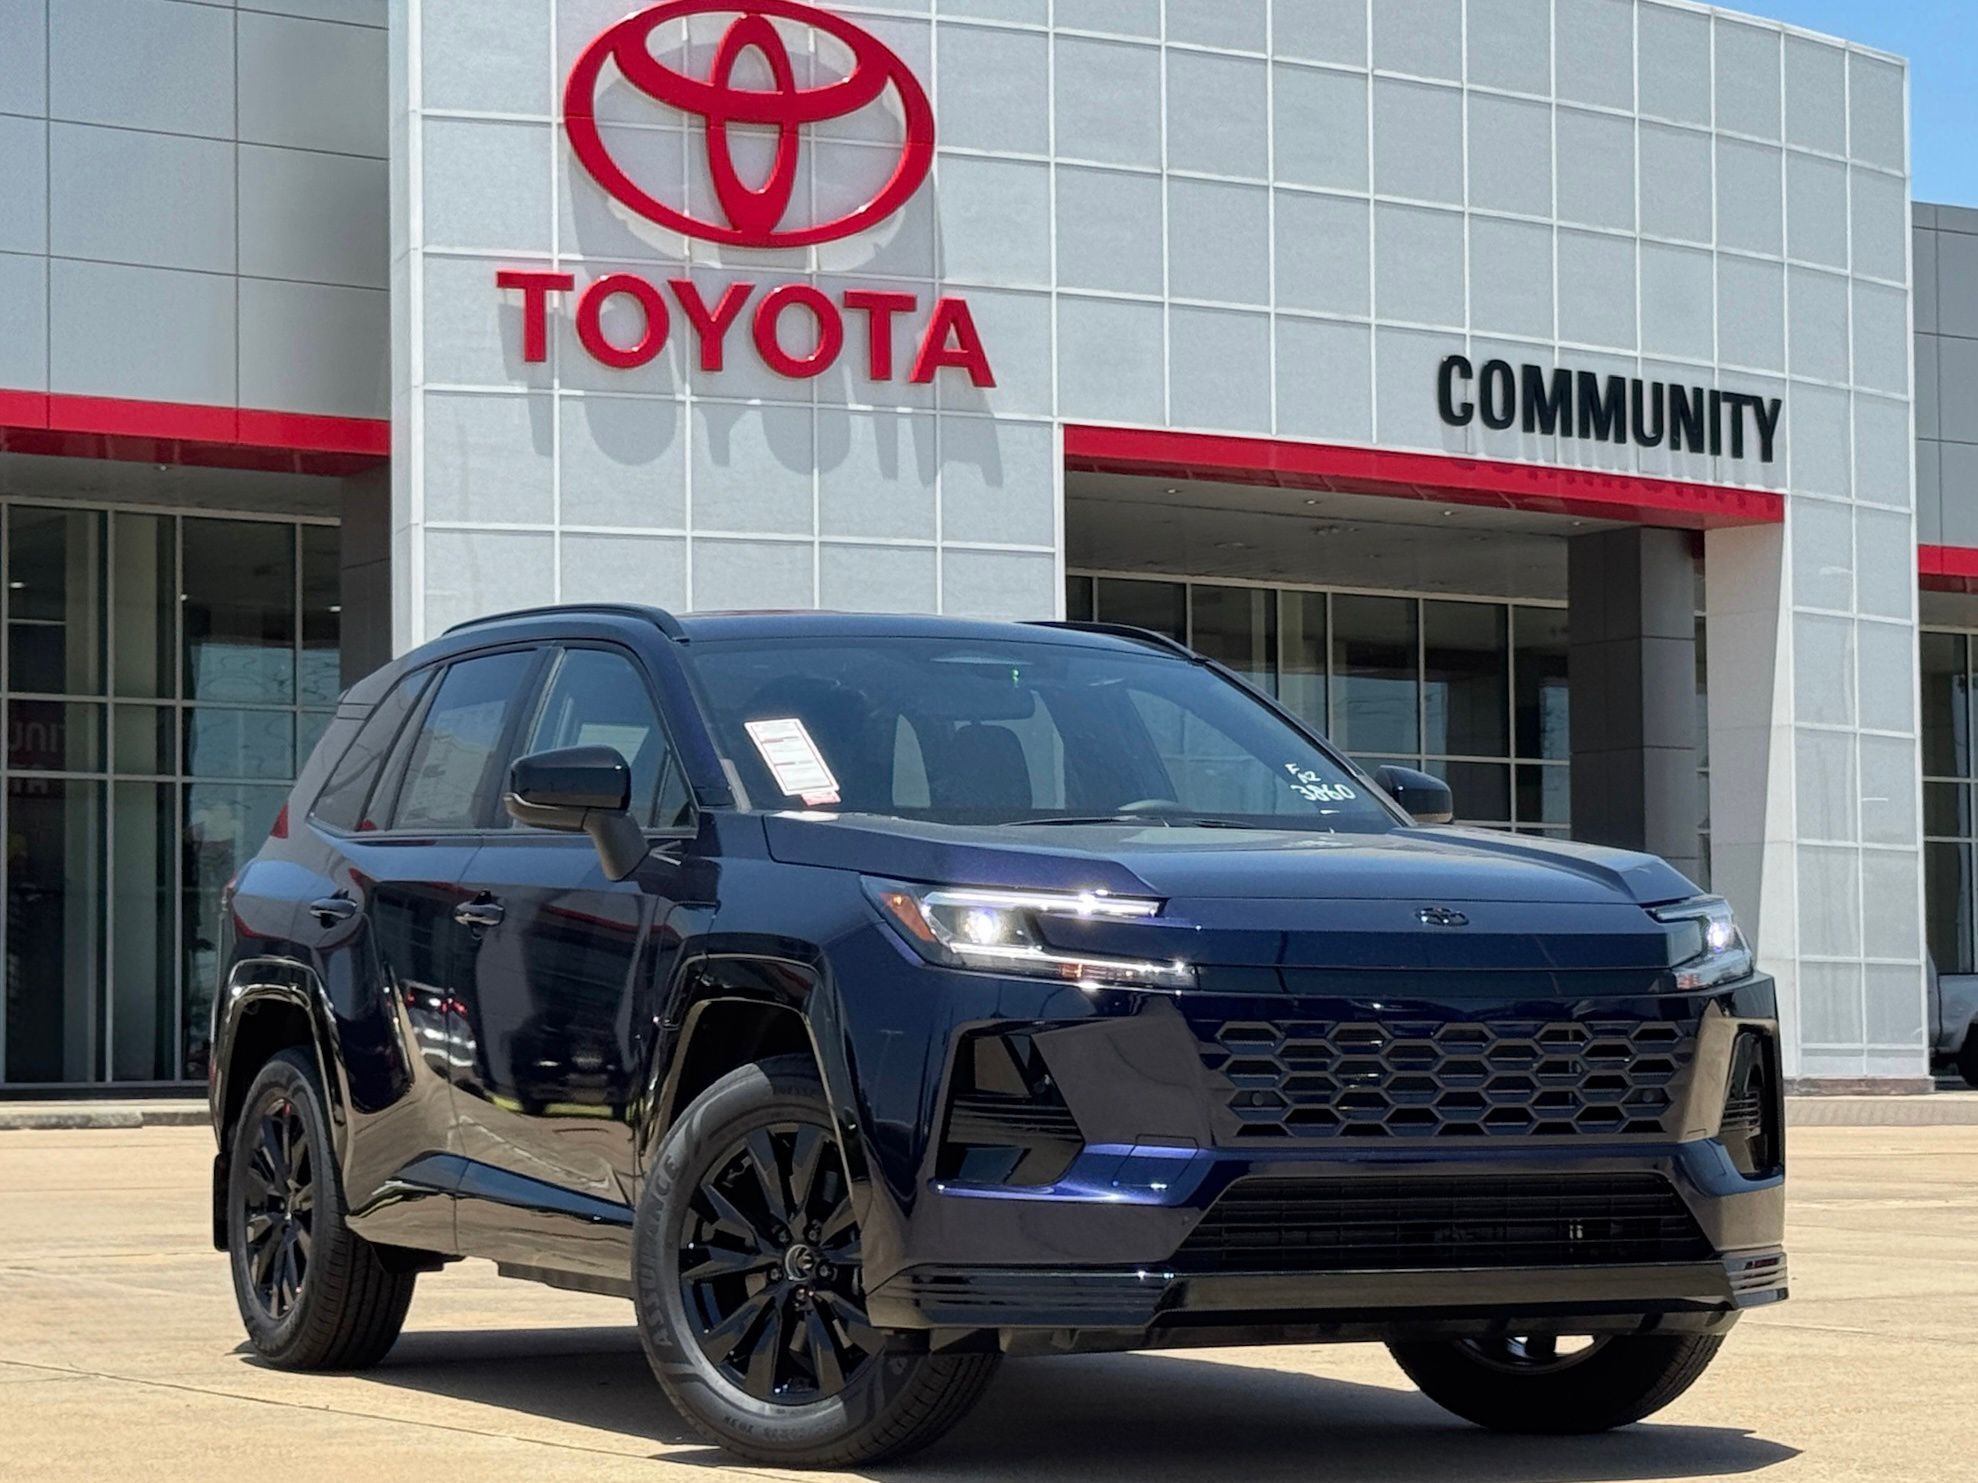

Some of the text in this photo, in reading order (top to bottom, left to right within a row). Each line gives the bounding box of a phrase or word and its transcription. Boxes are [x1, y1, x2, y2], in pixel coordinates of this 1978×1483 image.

[496, 270, 997, 388] TOYOTA
[1437, 354, 1782, 463] COMMUNITY
[1290, 784, 1356, 801] 3860
